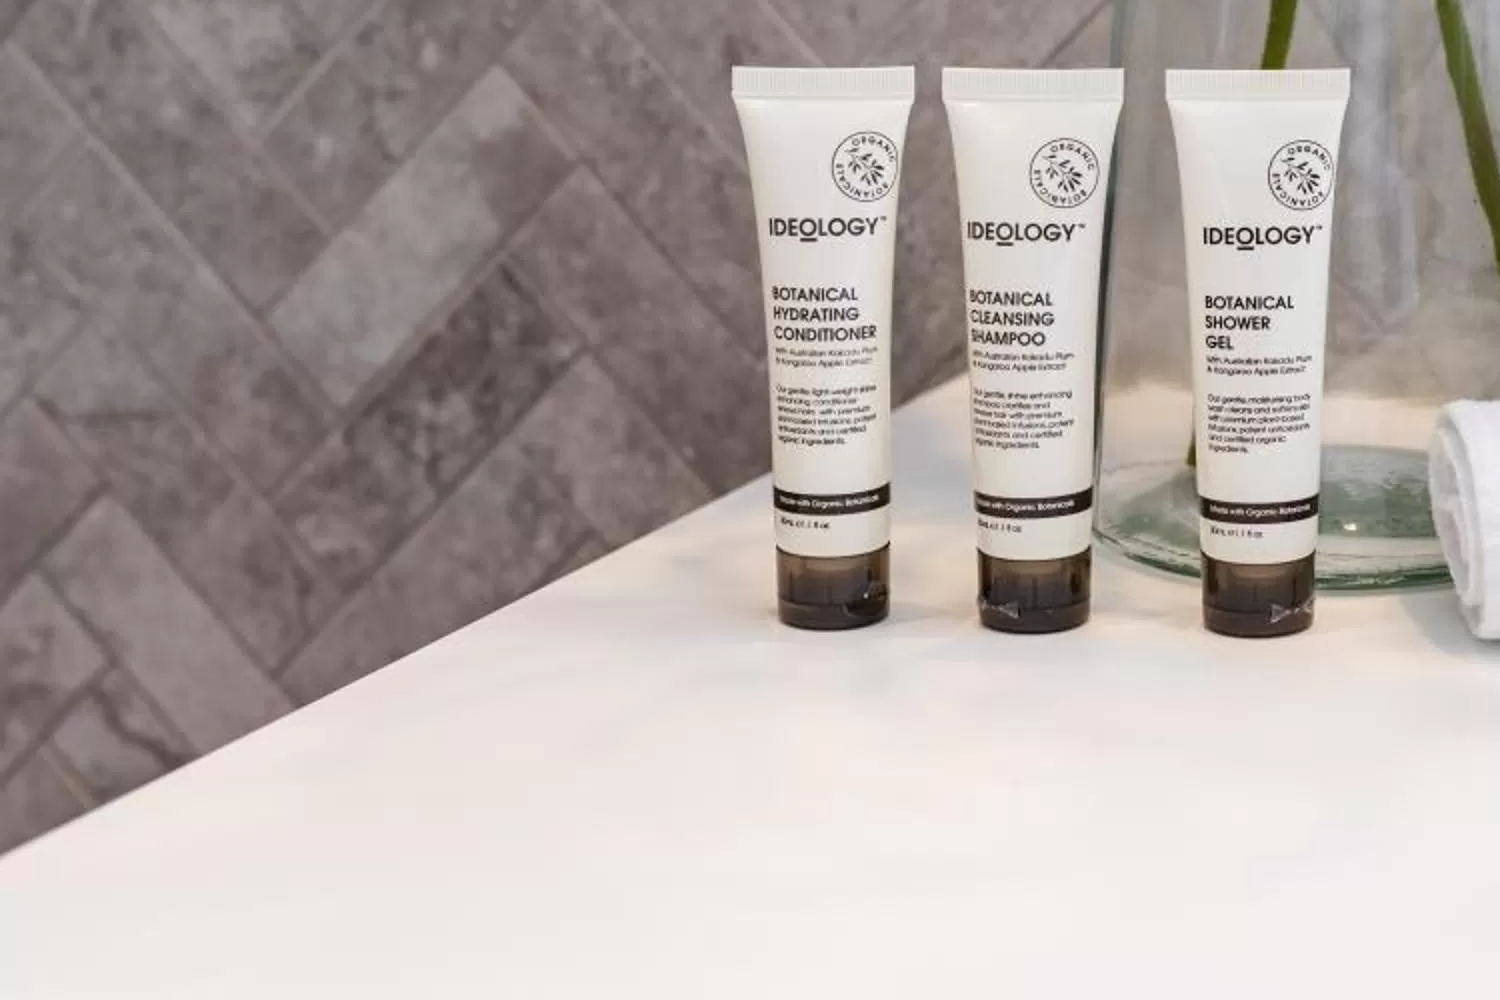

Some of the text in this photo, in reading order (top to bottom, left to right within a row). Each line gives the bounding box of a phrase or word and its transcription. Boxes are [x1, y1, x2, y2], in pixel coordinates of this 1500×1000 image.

[772, 286, 858, 301] BOTANICAL
[969, 289, 1053, 306] BOTANICAL
[1205, 295, 1295, 310] BOTANICAL
[773, 306, 860, 321] HYDRATING
[970, 309, 1055, 326] CLEANSING
[1205, 315, 1271, 331] SHOWER
[774, 325, 877, 342] CONDITIONER
[971, 329, 1046, 346] SHAMPOO
[1206, 335, 1234, 350] GEL
